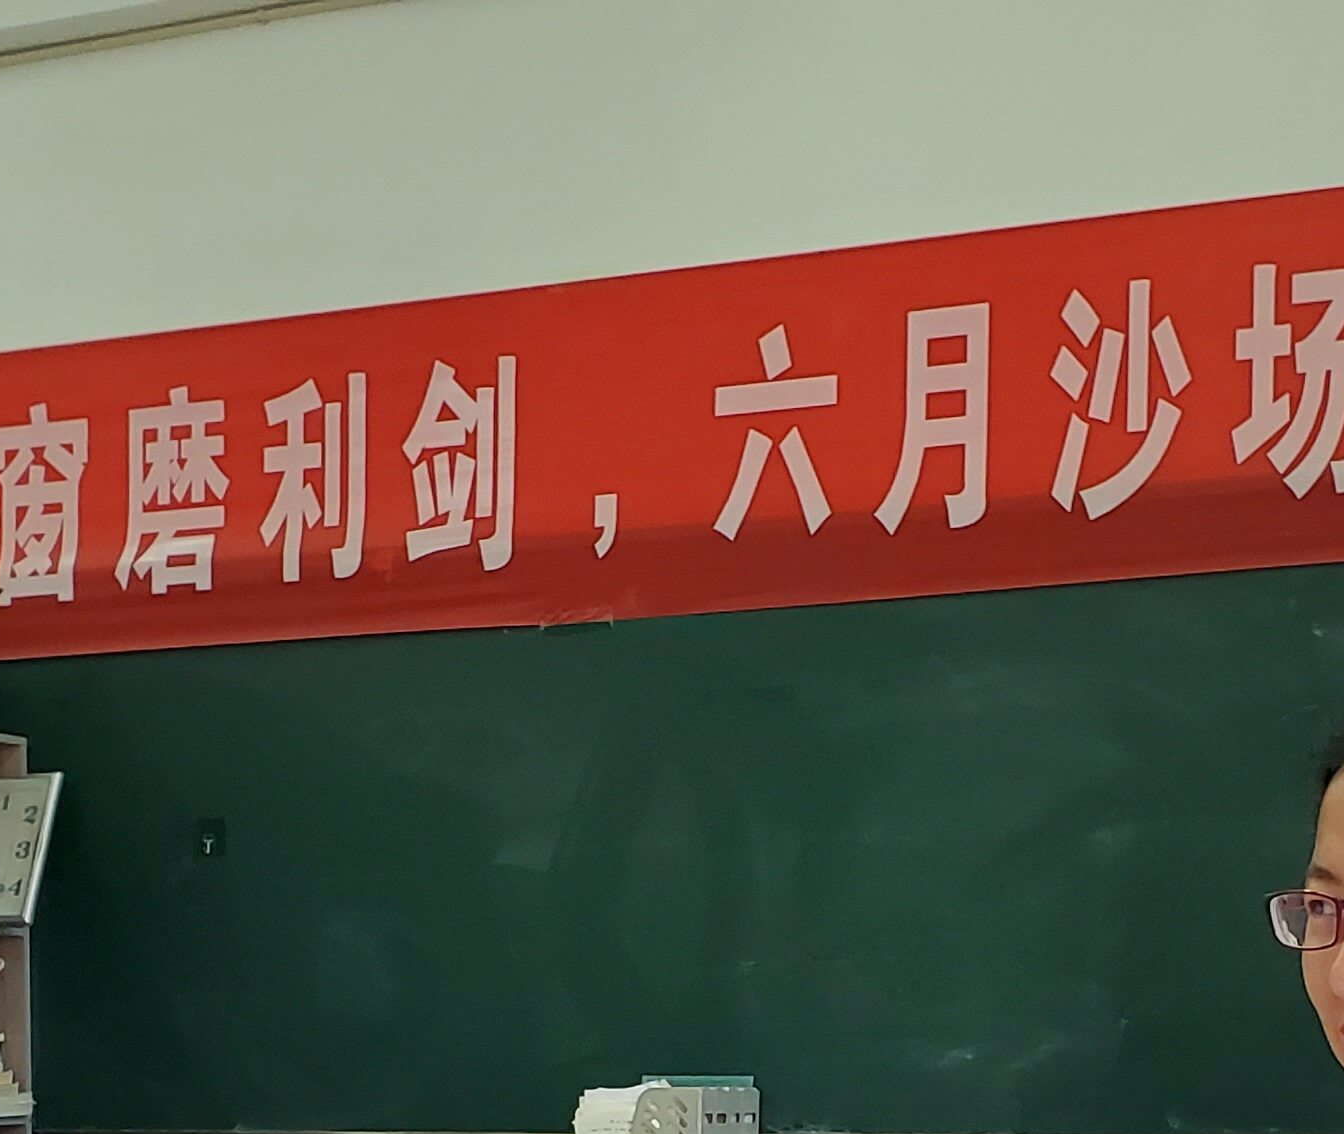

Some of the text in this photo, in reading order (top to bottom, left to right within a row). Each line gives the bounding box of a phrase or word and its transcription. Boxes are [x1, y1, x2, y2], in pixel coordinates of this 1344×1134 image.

[23, 805, 38, 824] 2
[15, 841, 30, 860] 3
[8, 879, 22, 896] 4
